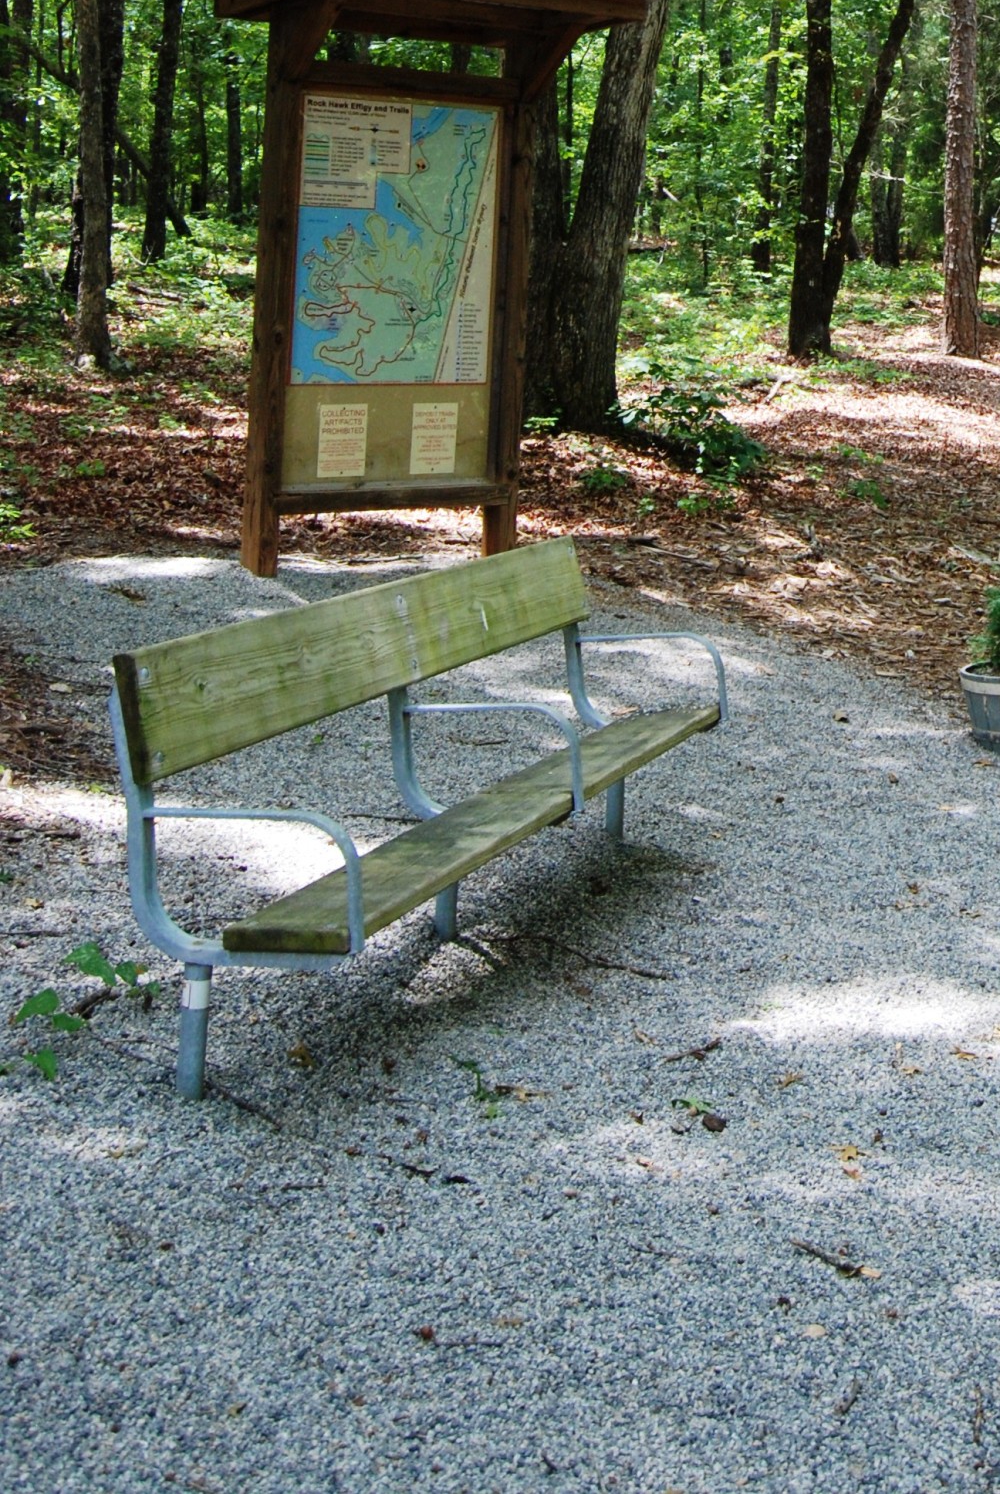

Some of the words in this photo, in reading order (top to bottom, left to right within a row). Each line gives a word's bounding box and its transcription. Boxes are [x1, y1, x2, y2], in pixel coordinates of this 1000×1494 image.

[307, 99, 326, 107] Rock
[351, 102, 372, 112] Effigy
[390, 106, 410, 114] Trails
[322, 409, 366, 418] COLLECTING
[324, 418, 363, 426] ARTIFACTS
[321, 427, 365, 435] PROHIBITED
